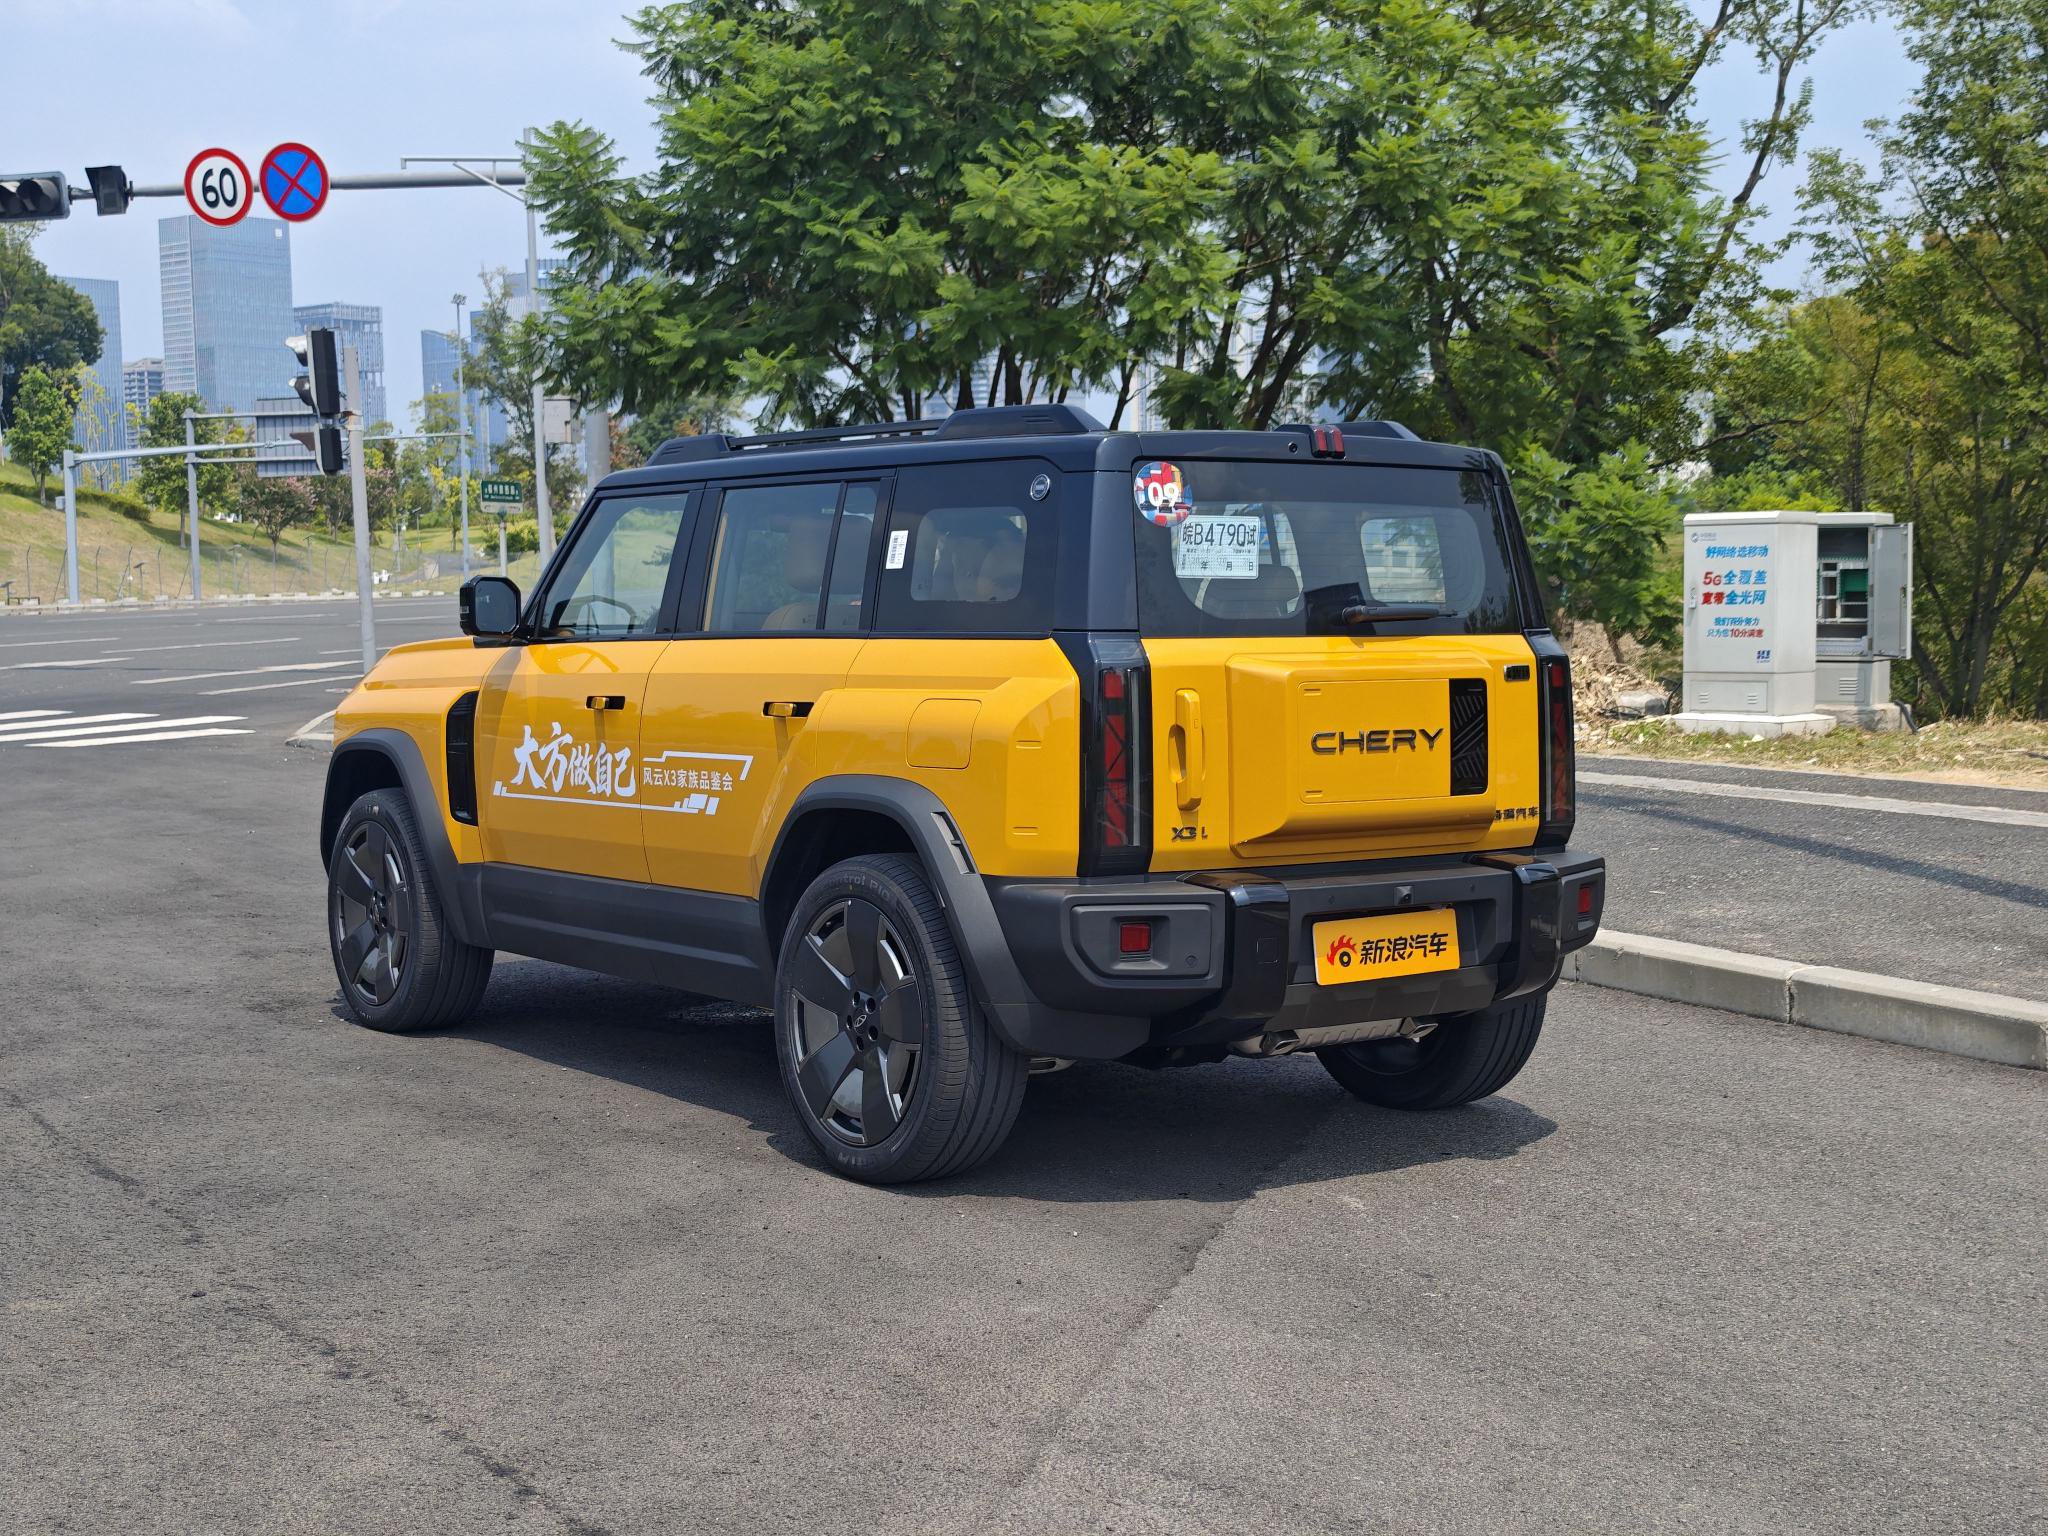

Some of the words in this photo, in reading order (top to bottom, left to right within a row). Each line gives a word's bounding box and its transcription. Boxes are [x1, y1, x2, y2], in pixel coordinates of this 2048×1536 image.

[202, 167, 238, 209] 60
[1310, 727, 1444, 756] CHERY
[510, 721, 637, 798] 大方做自己
[643, 767, 733, 792] 风云X3家族品鉴会
[1360, 932, 1449, 966] 新浪汽车
